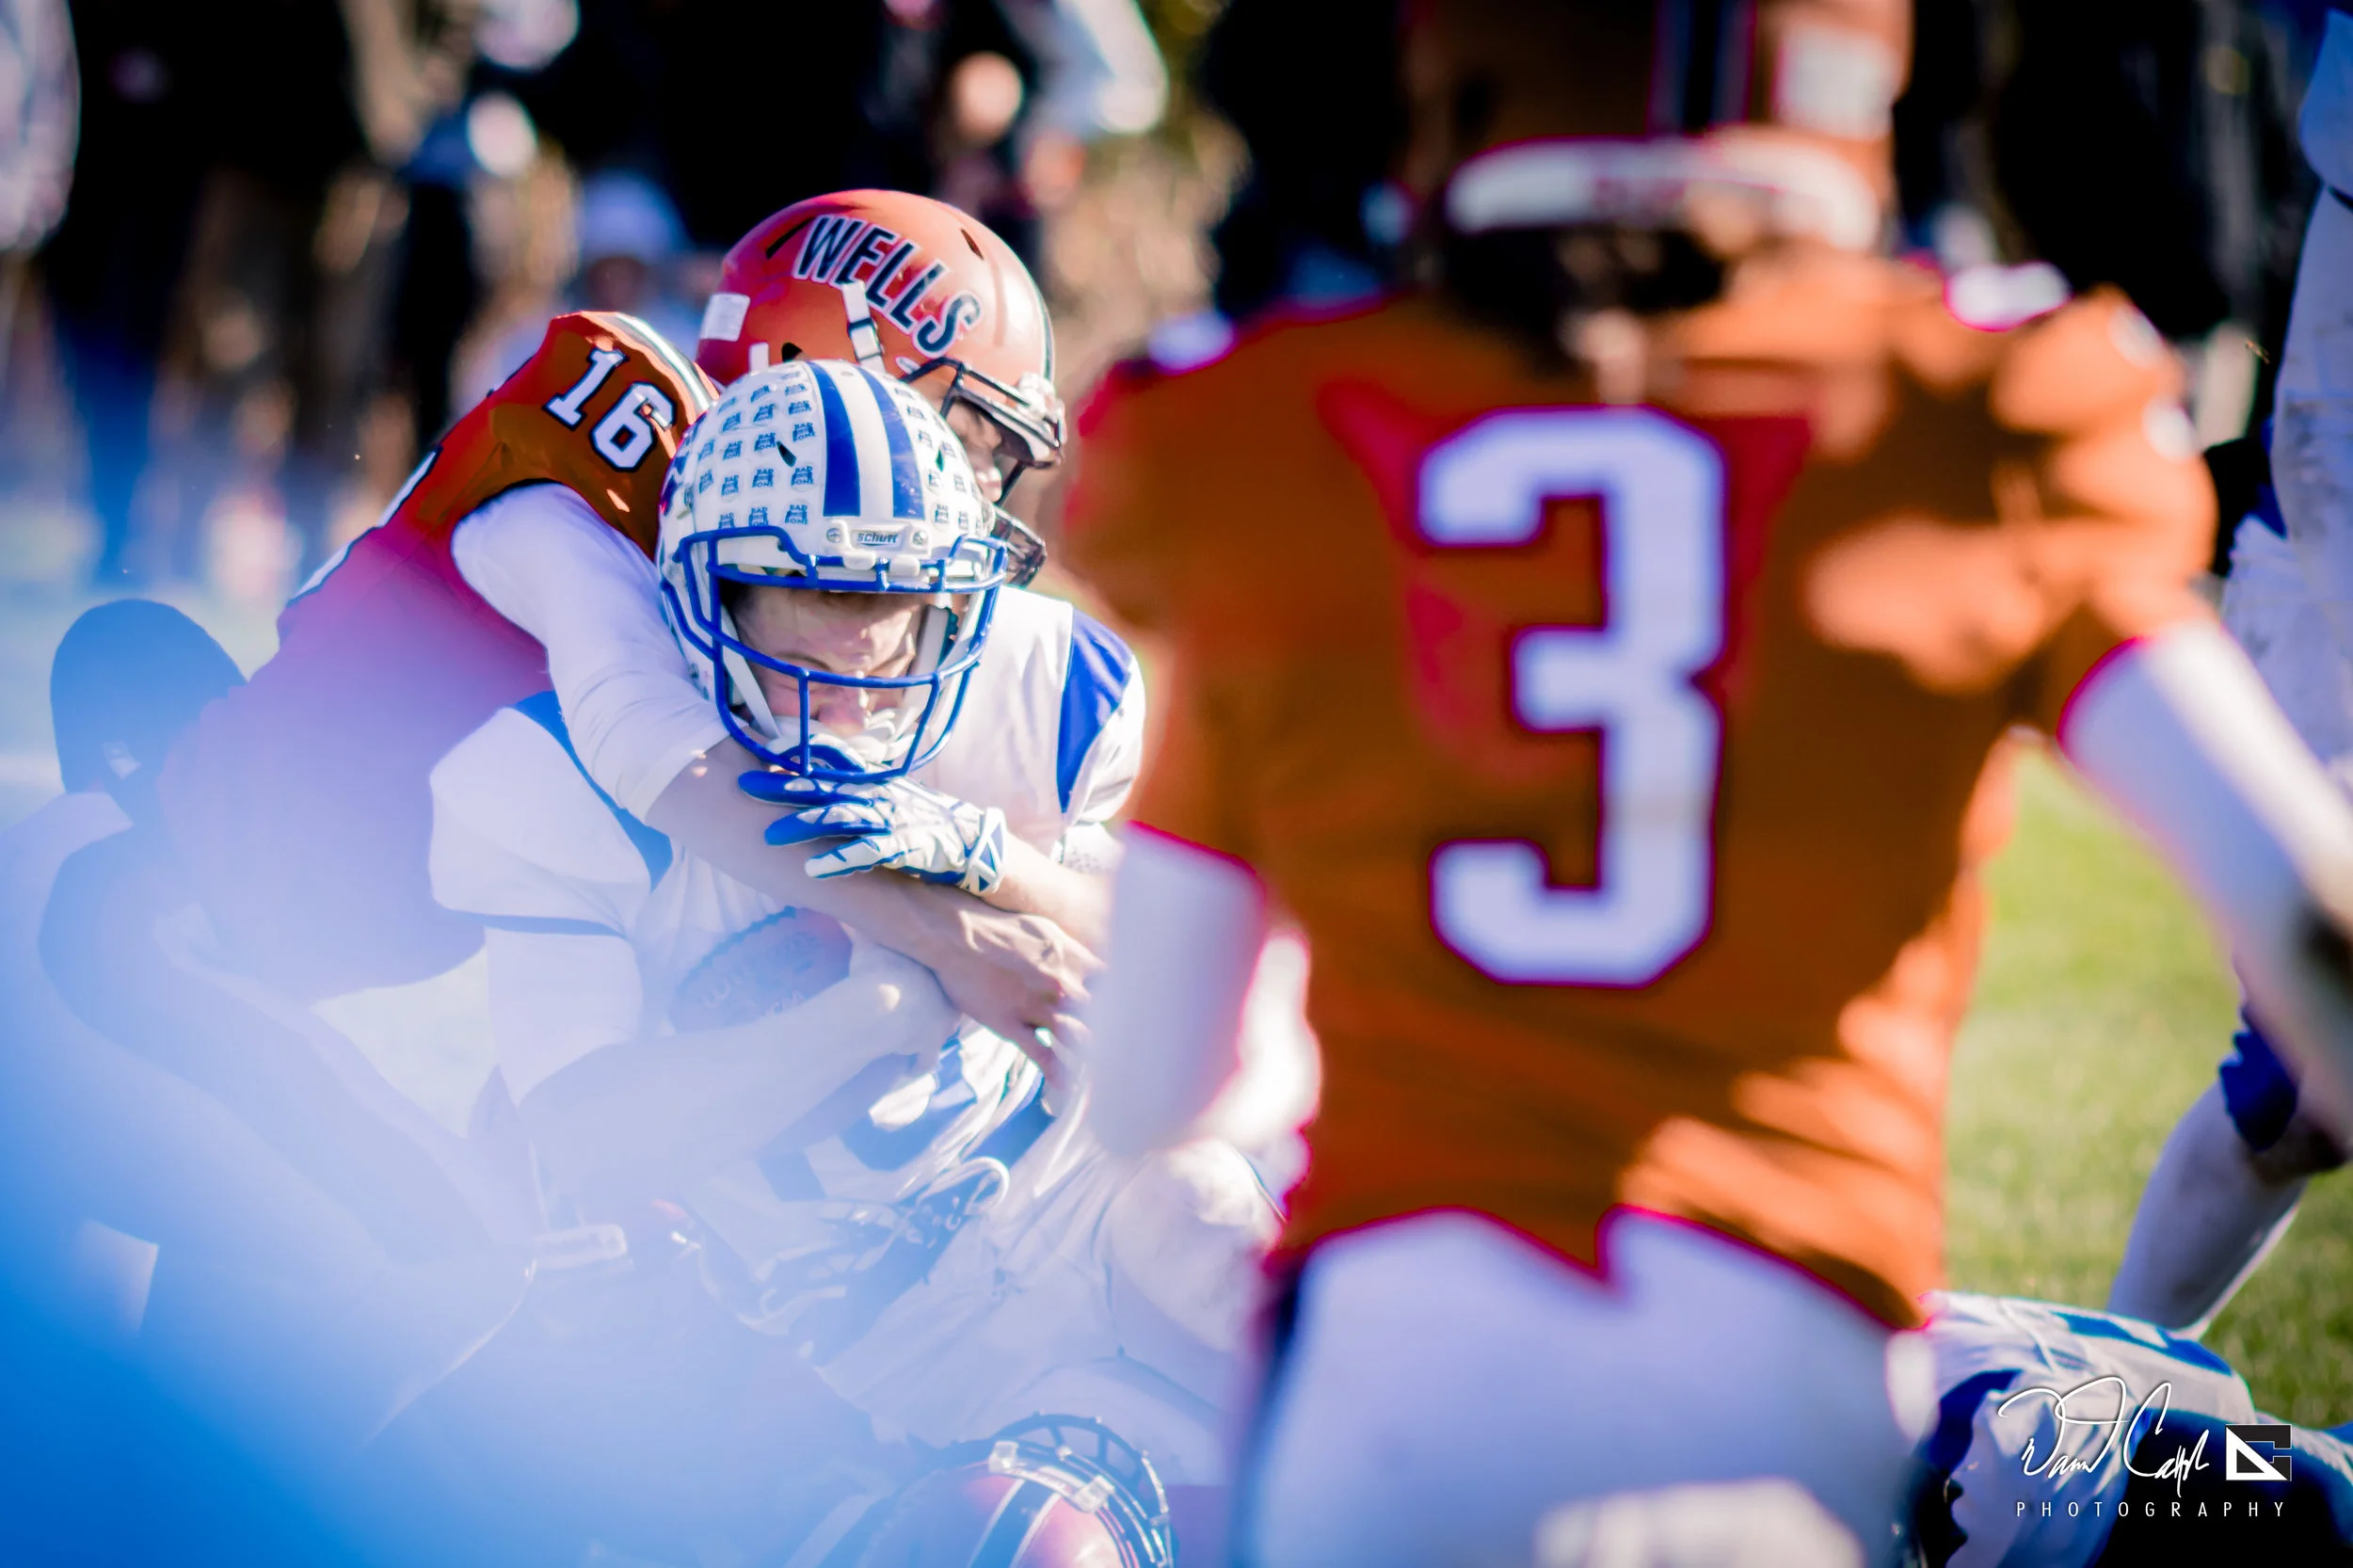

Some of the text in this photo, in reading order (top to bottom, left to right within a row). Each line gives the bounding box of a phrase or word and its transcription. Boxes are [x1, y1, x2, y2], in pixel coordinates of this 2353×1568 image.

[791, 214, 984, 360] WELLS
[543, 346, 679, 472] 16
[1416, 405, 1728, 989] 3
